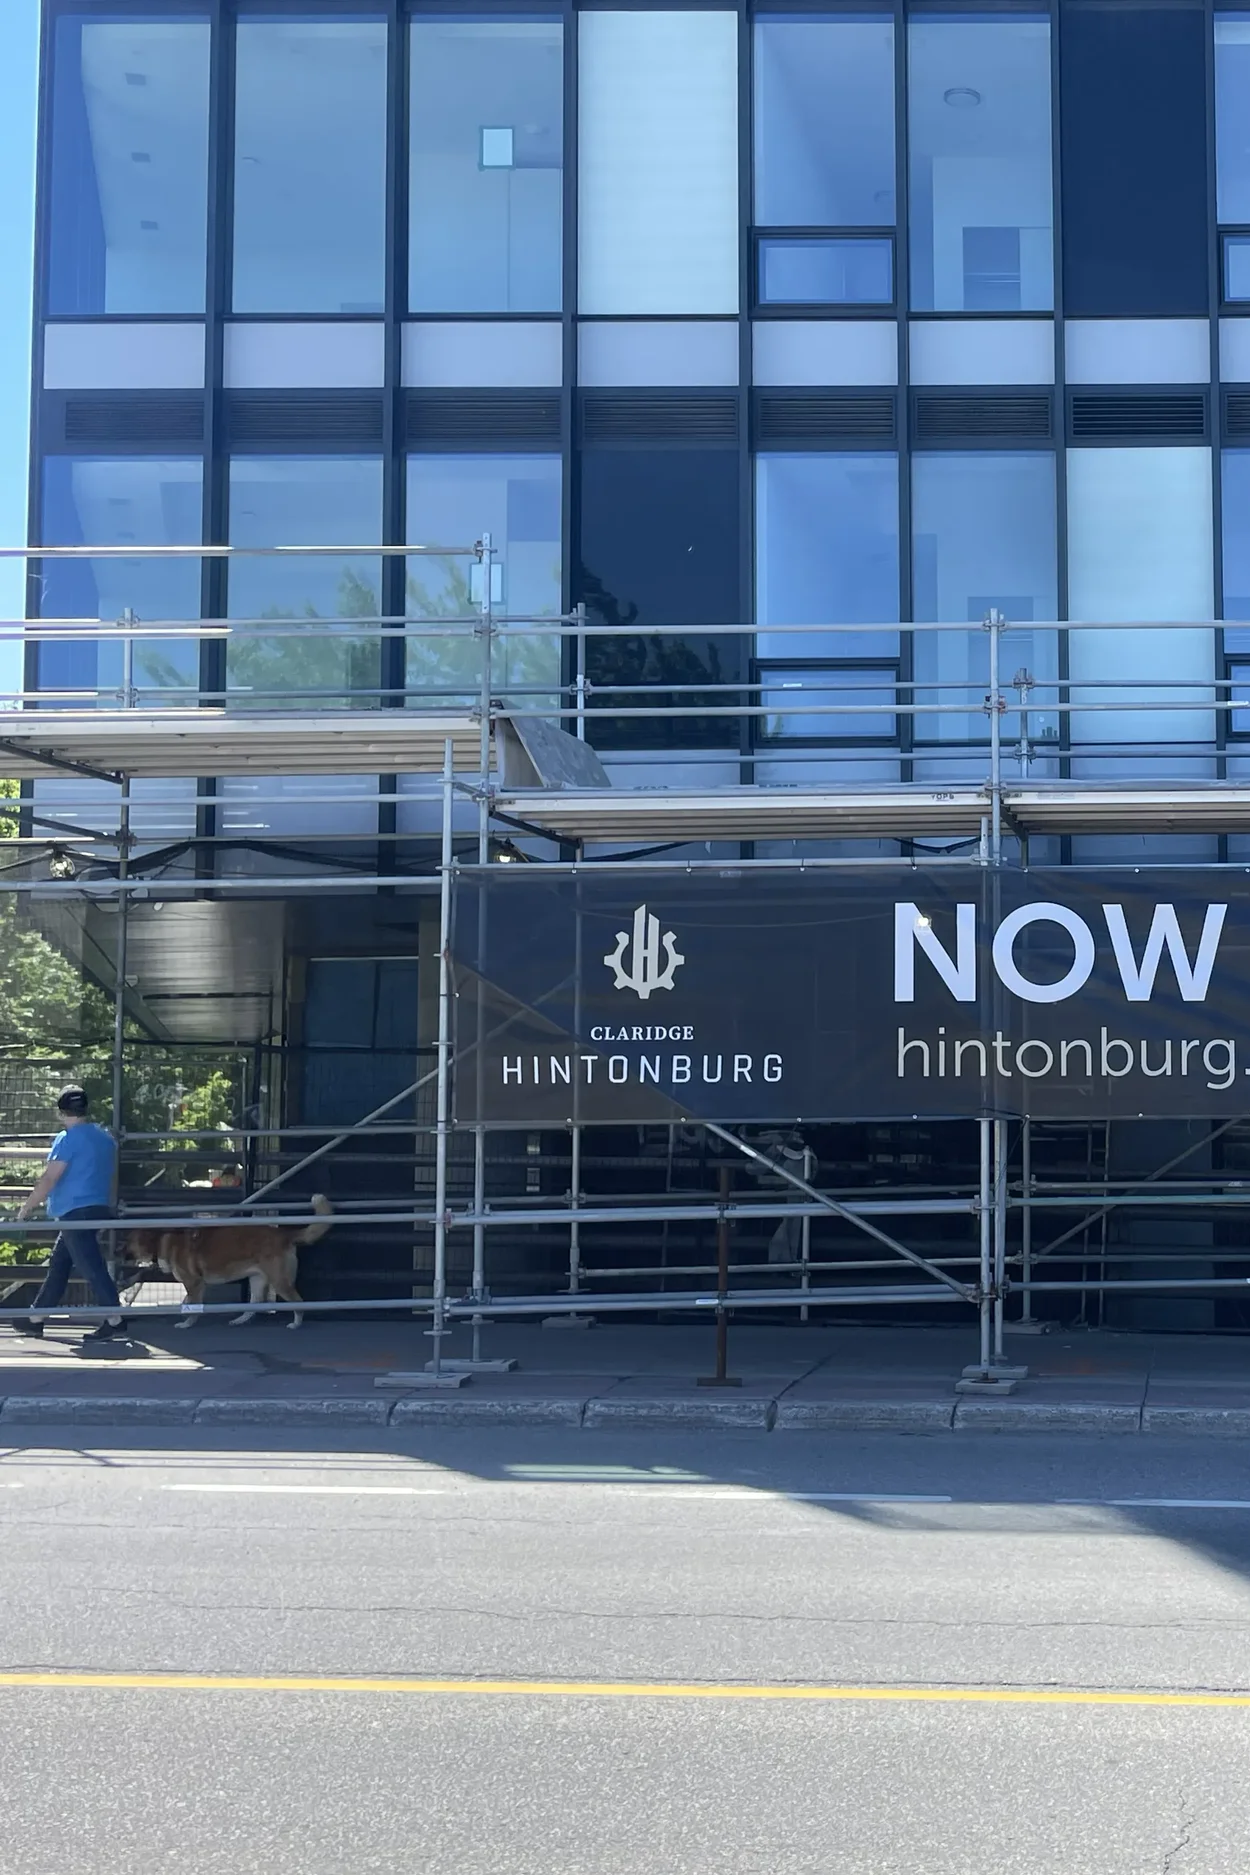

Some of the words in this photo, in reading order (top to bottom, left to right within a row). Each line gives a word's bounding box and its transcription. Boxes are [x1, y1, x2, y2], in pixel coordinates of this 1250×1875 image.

[894, 902, 1228, 1003] NOW
[590, 1025, 694, 1041] CLARIDGE
[502, 1054, 783, 1085] HINTONBURG
